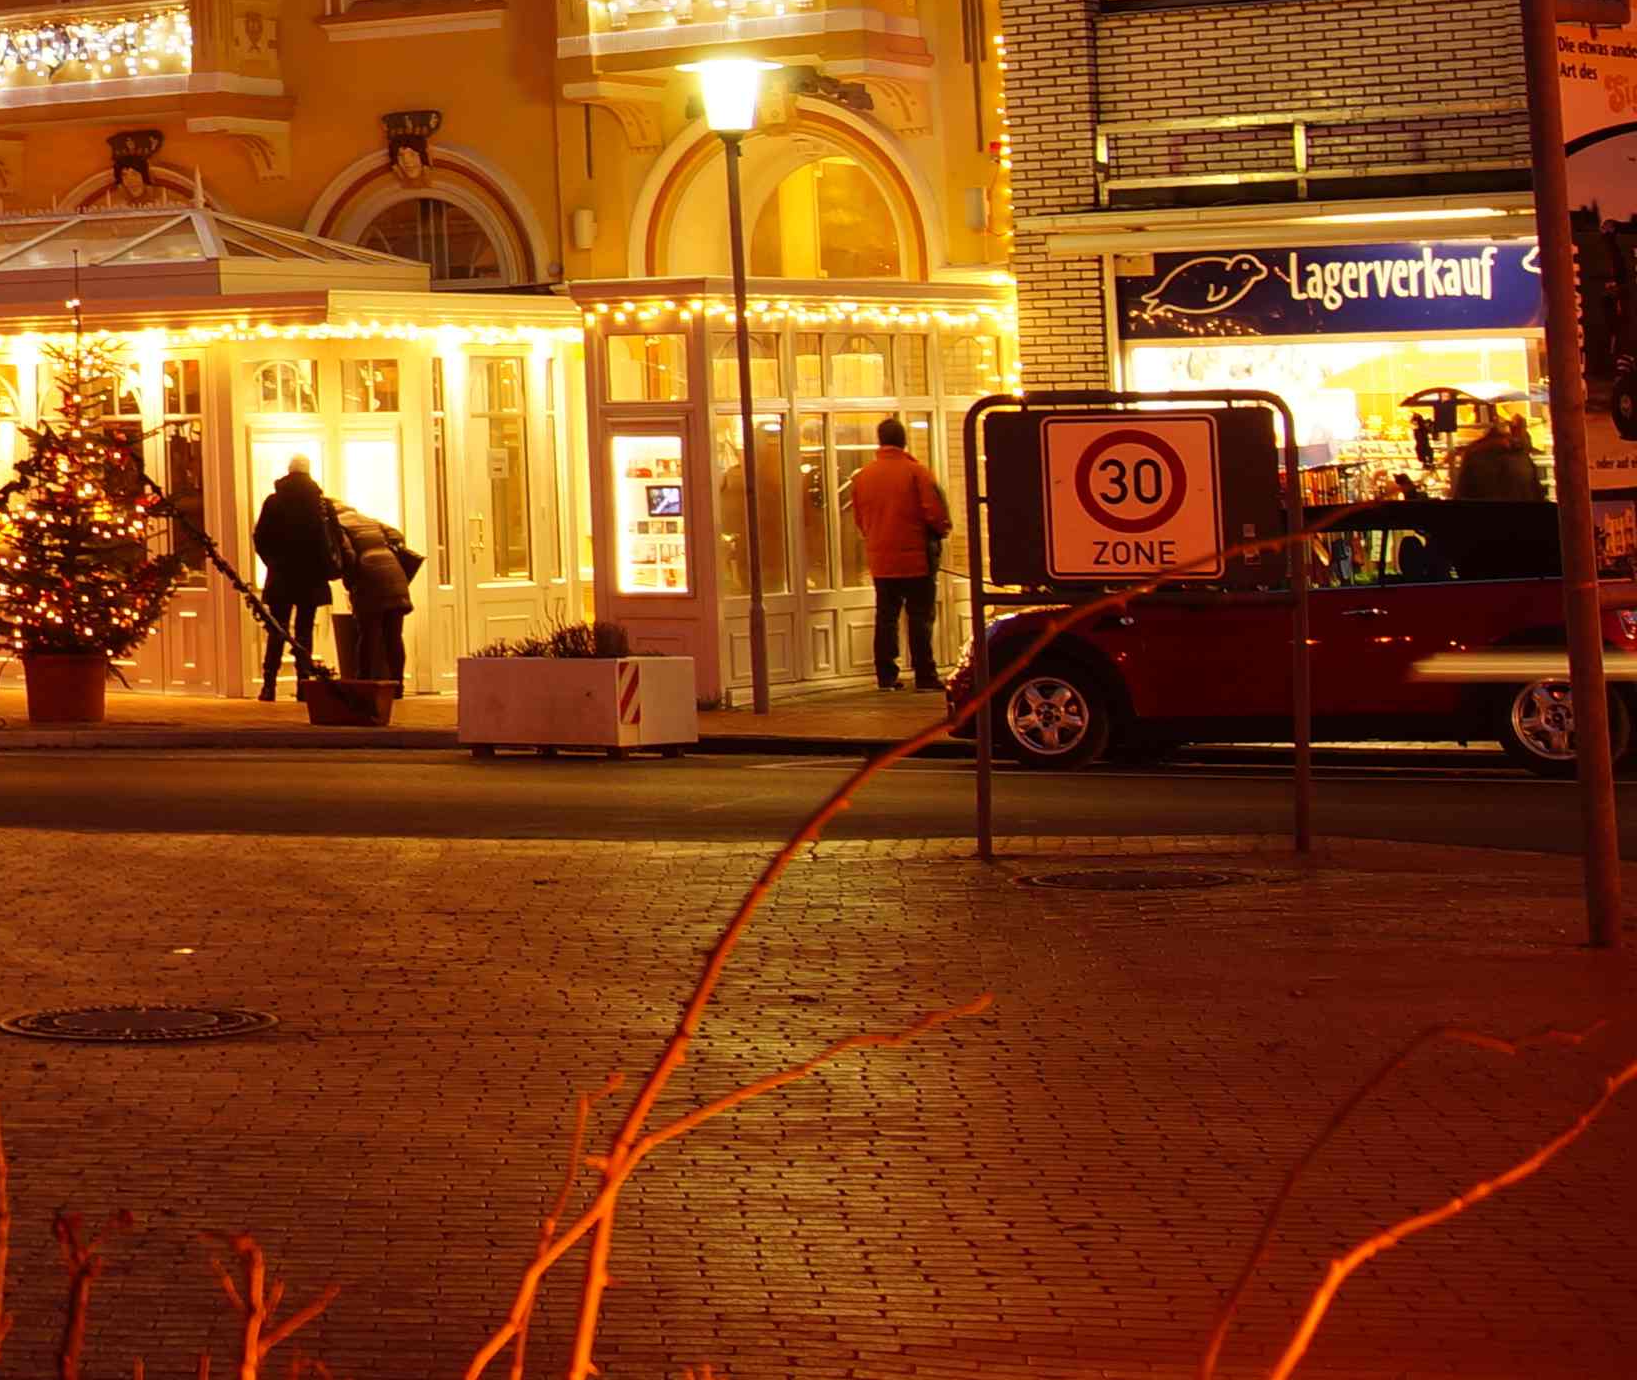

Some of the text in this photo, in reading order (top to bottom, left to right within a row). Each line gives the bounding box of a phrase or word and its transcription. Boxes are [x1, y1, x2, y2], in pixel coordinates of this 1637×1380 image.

[1557, 36, 1575, 53] Die
[1578, 40, 1609, 56] etwas
[1560, 62, 1598, 80] Art des
[1289, 246, 1498, 311] Lagerverkauf
[1099, 458, 1162, 505] 30
[1092, 540, 1176, 565] ZONE
